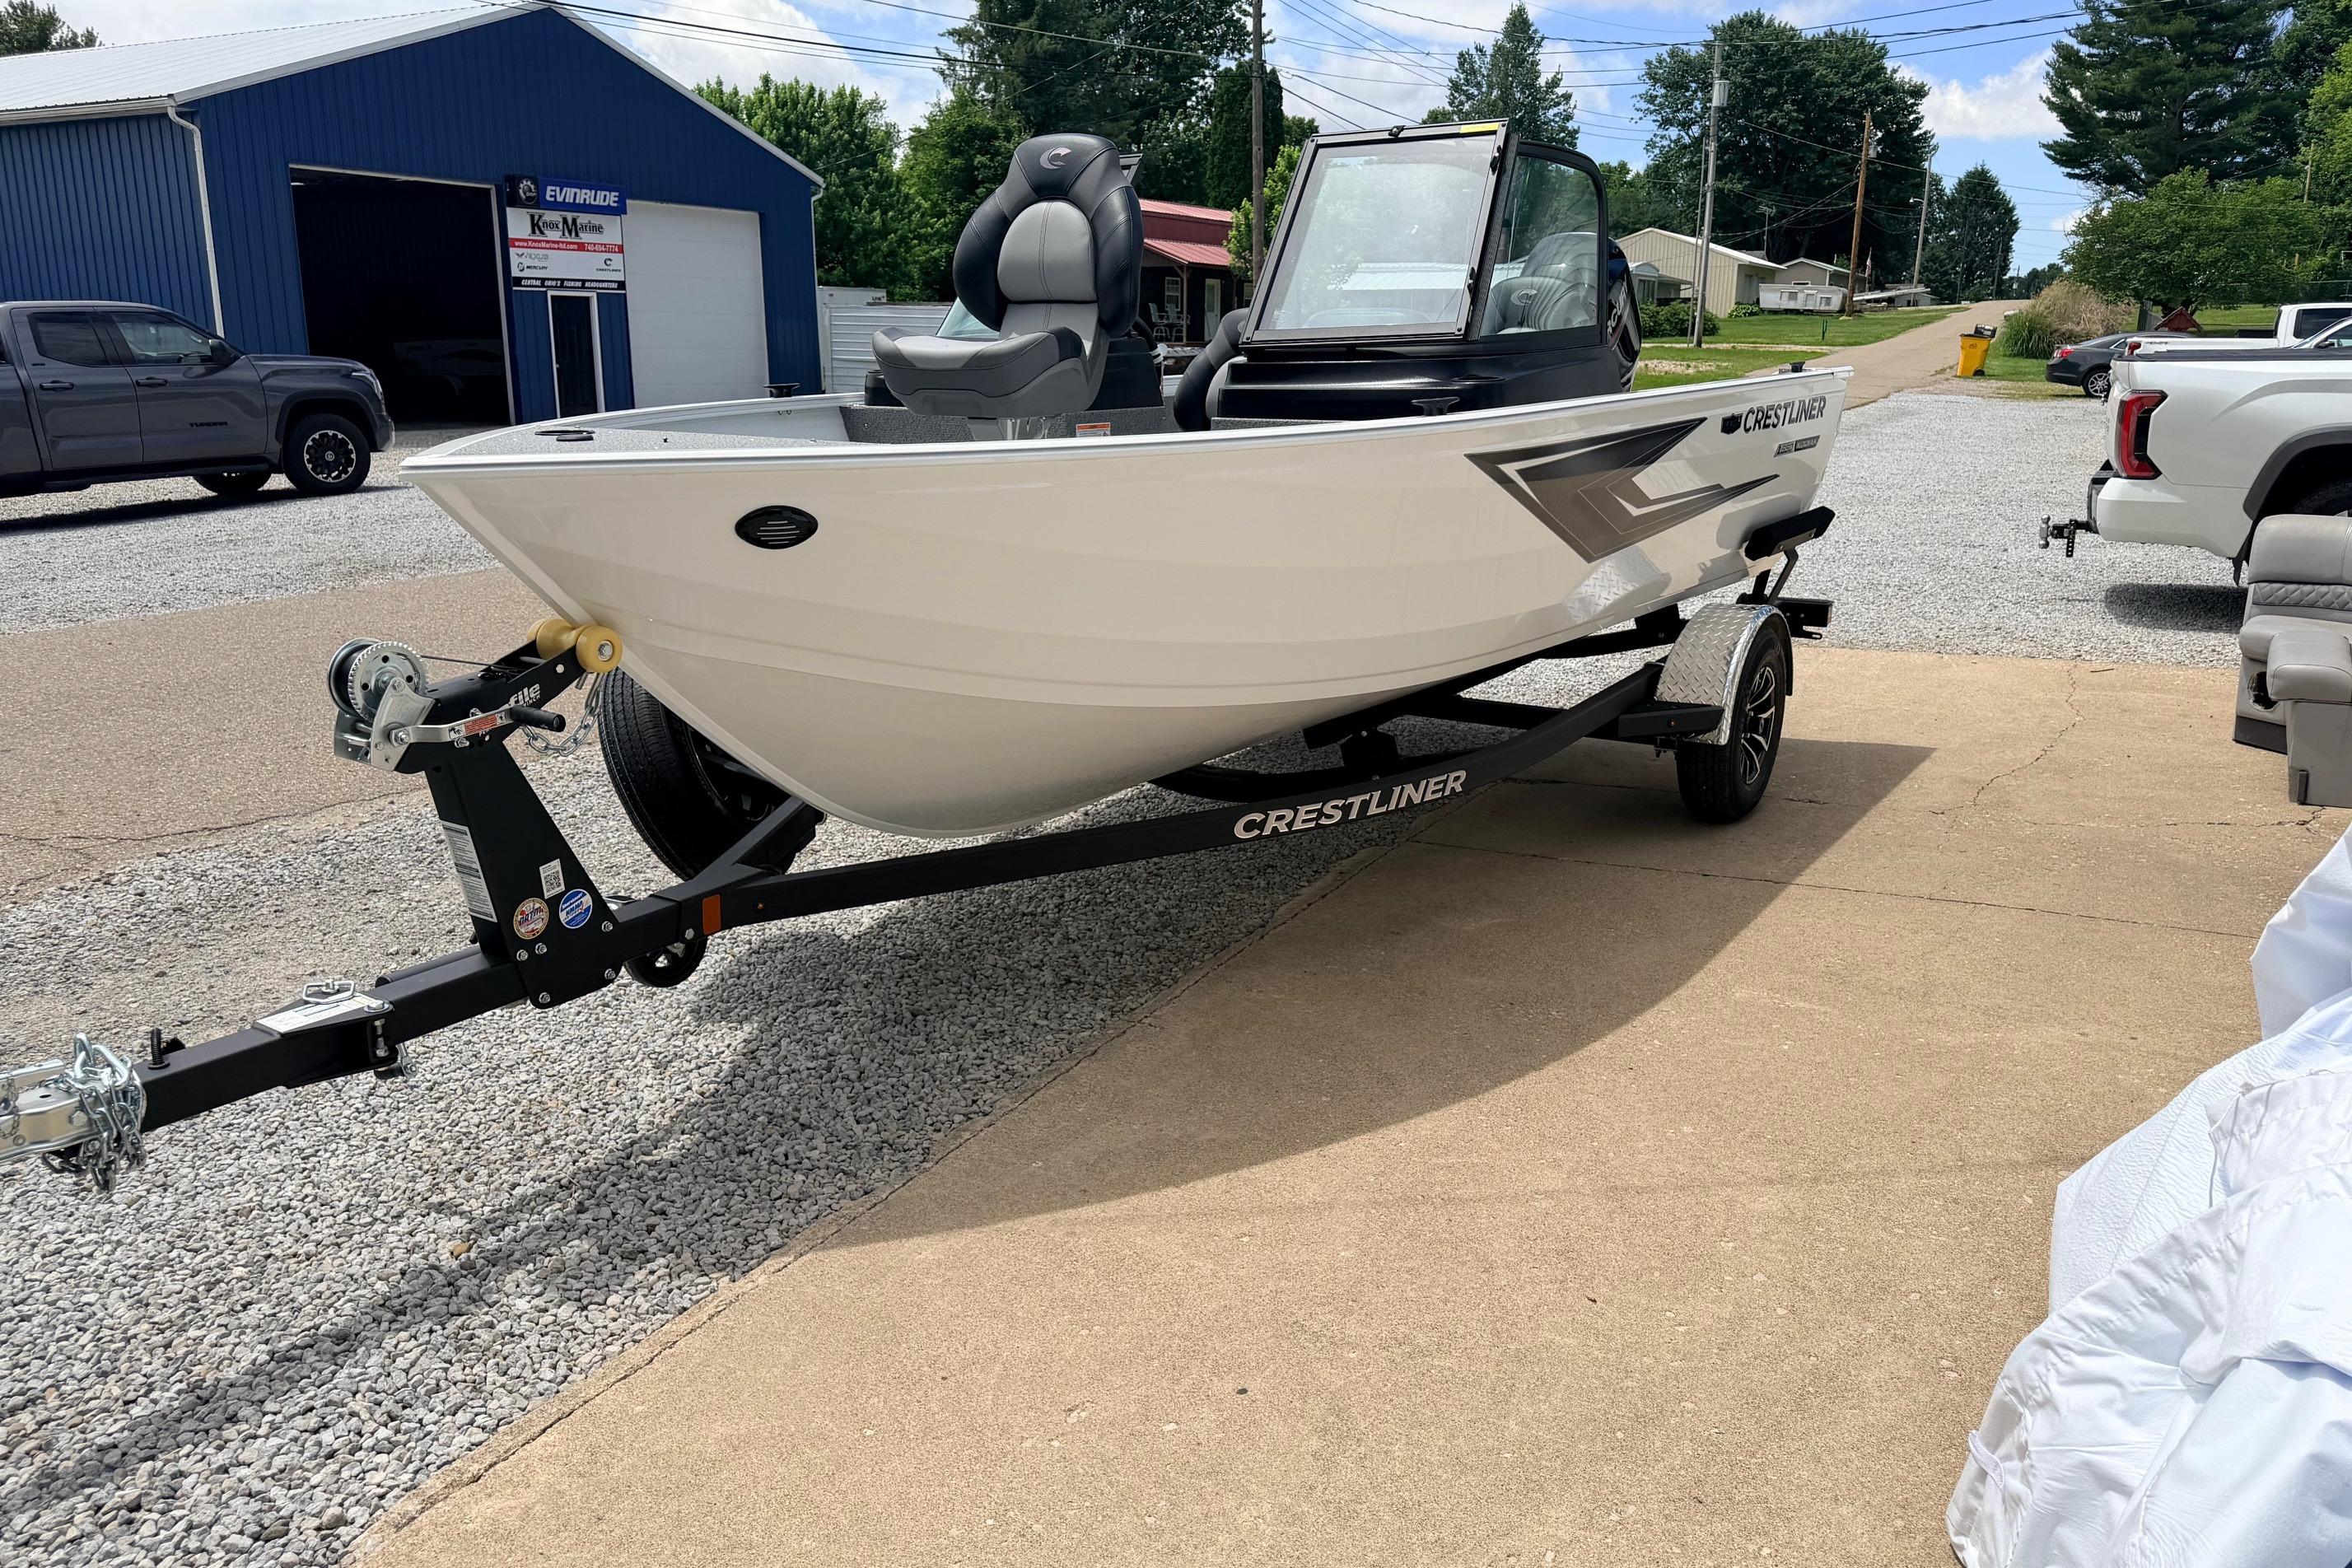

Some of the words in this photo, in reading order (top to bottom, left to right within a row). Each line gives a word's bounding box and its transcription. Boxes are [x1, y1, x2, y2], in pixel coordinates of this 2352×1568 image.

[546, 185, 619, 207] EVINRUDE
[526, 212, 562, 237] Knox
[559, 214, 604, 239] Marine
[1743, 395, 1827, 433] CRESTLINER
[509, 684, 540, 707] file
[1234, 769, 1467, 839] CRESTLINER
